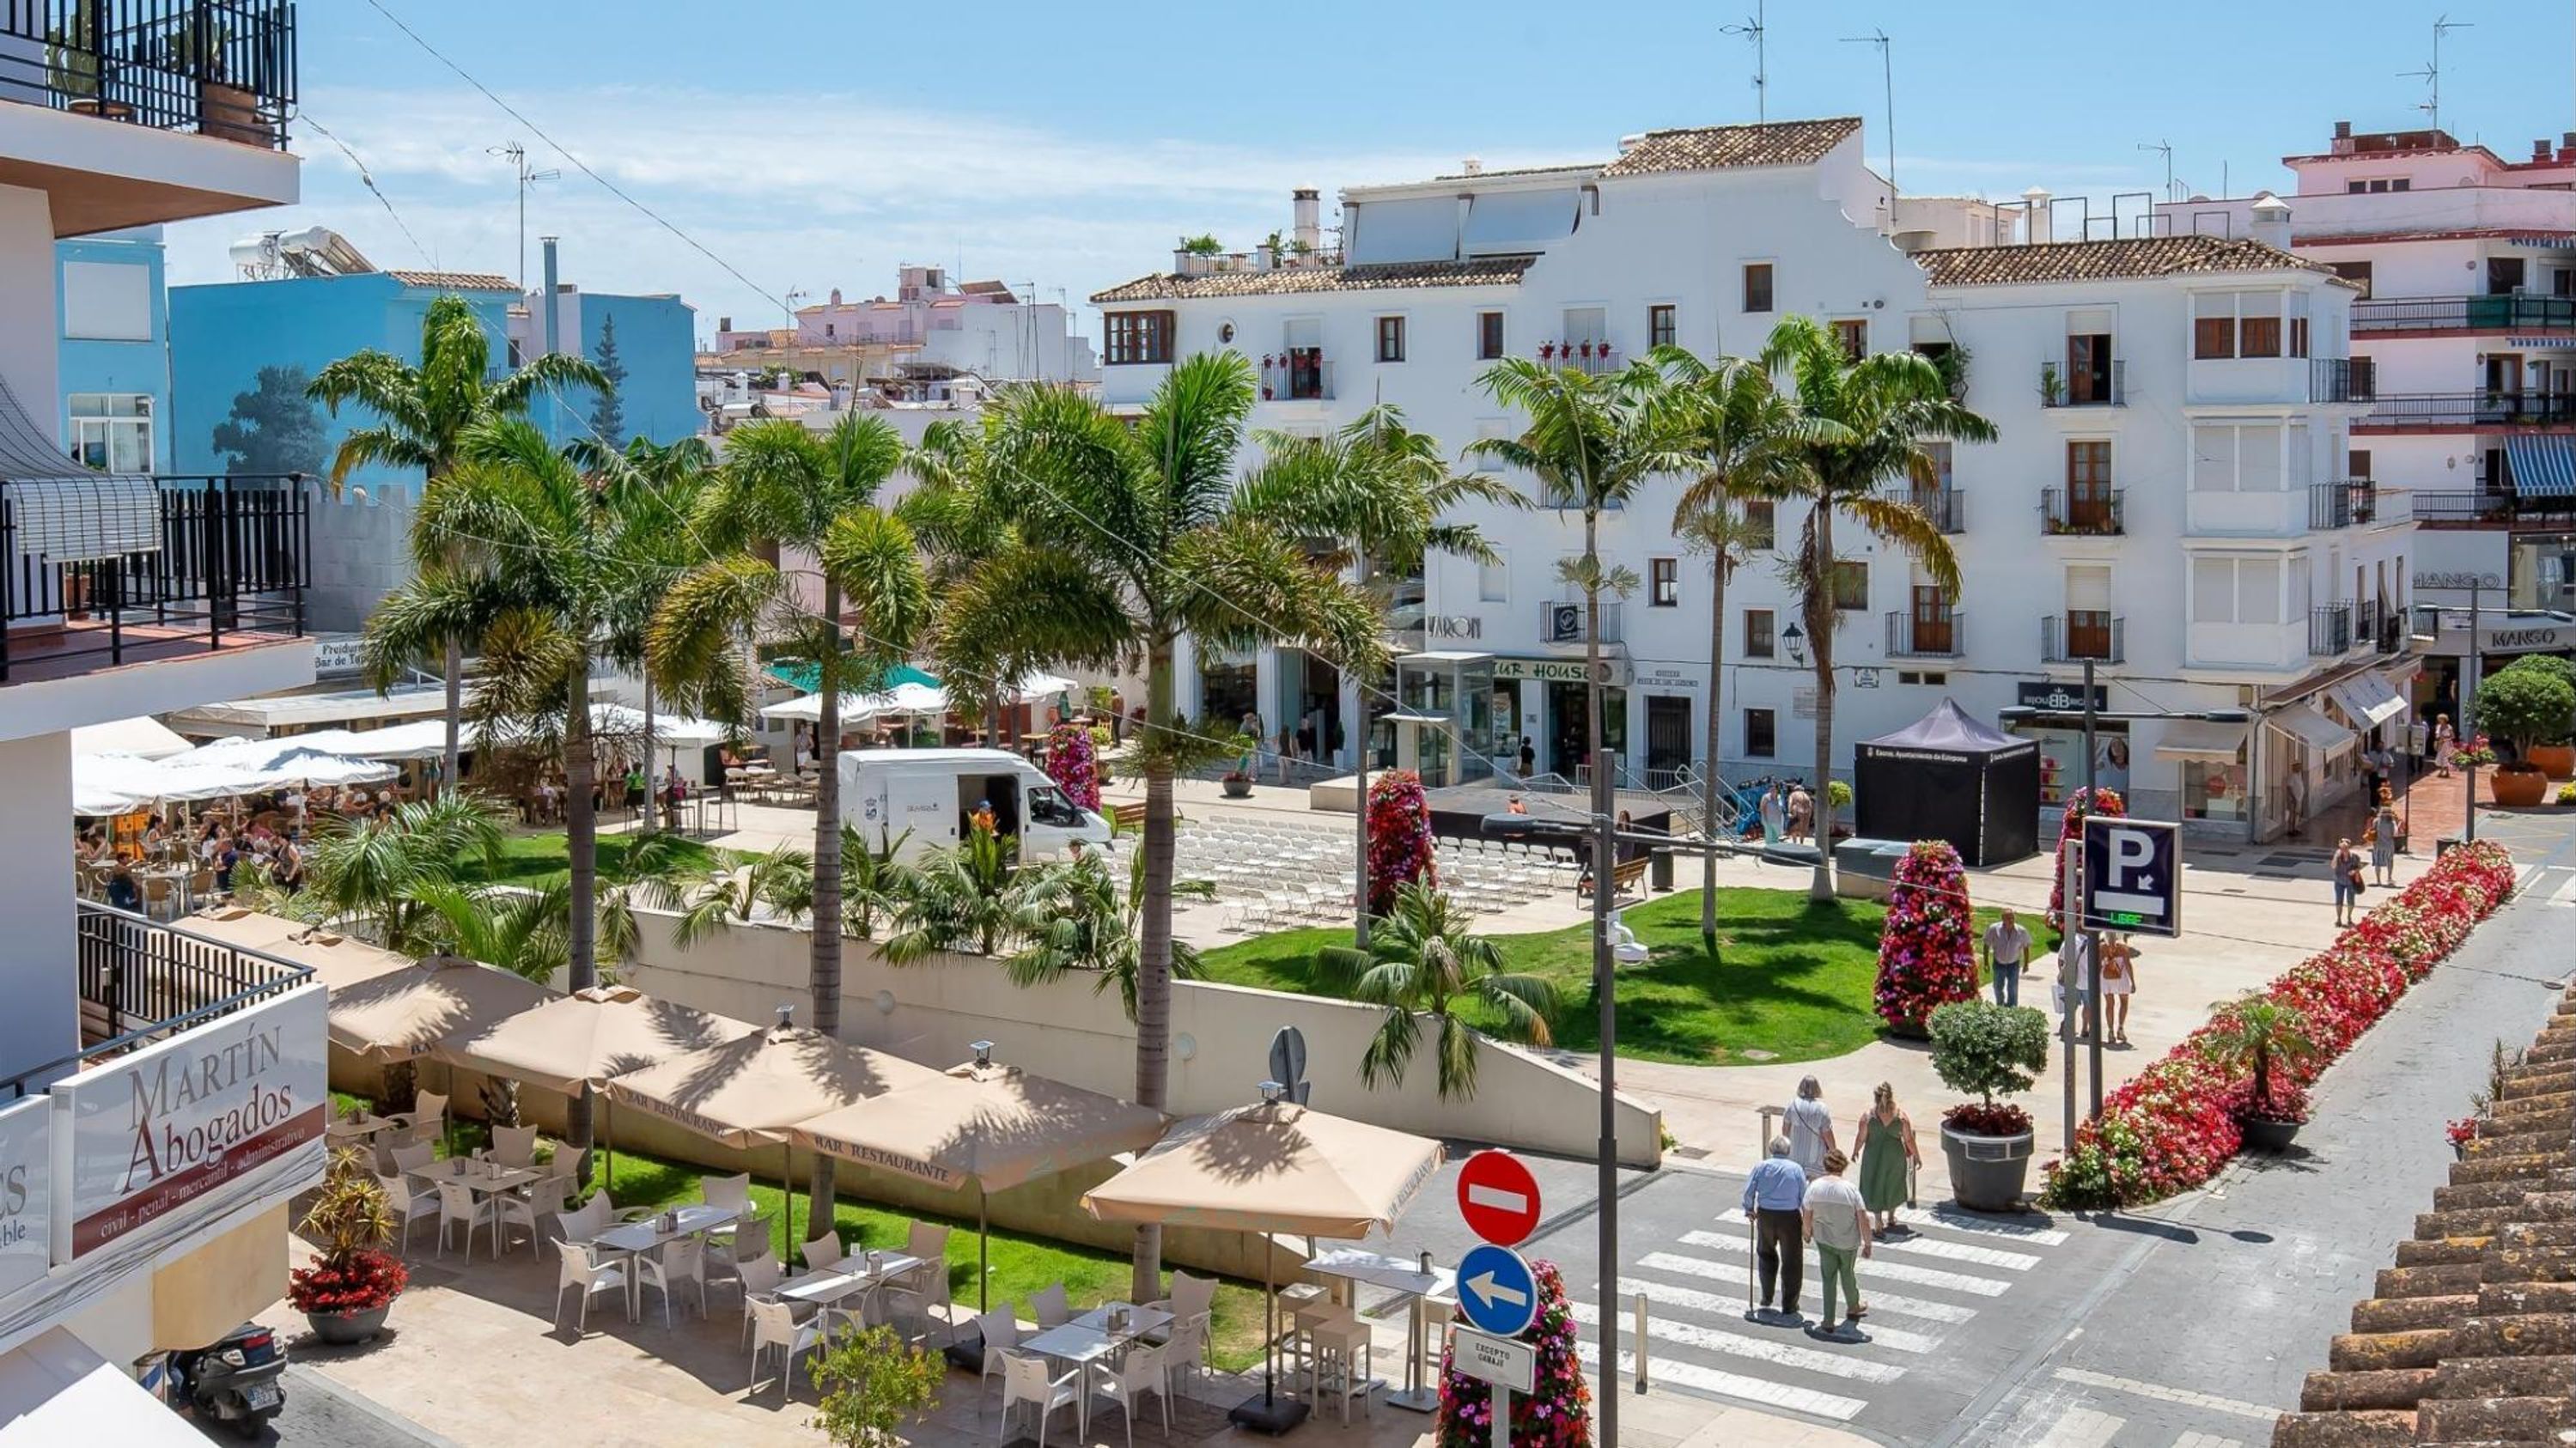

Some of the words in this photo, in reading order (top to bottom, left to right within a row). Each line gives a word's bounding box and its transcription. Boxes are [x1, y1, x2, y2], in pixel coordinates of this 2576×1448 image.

[2492, 628, 2557, 648] MANGO
[334, 655, 346, 666] de
[2109, 828, 2154, 888] P
[126, 1021, 282, 1132] MARTÍN
[625, 1089, 648, 1109] BAR
[120, 1083, 292, 1196] Abogados
[814, 1134, 844, 1153] BAR
[850, 1143, 949, 1183] RESTAURANTE
[100, 1207, 127, 1238] civil
[137, 1190, 169, 1225] penal
[179, 1161, 228, 1201] mercantil
[237, 1127, 305, 1171] administrativo
[0, 1219, 26, 1248] ble
[1476, 1342, 1511, 1360] EXCEPTO
